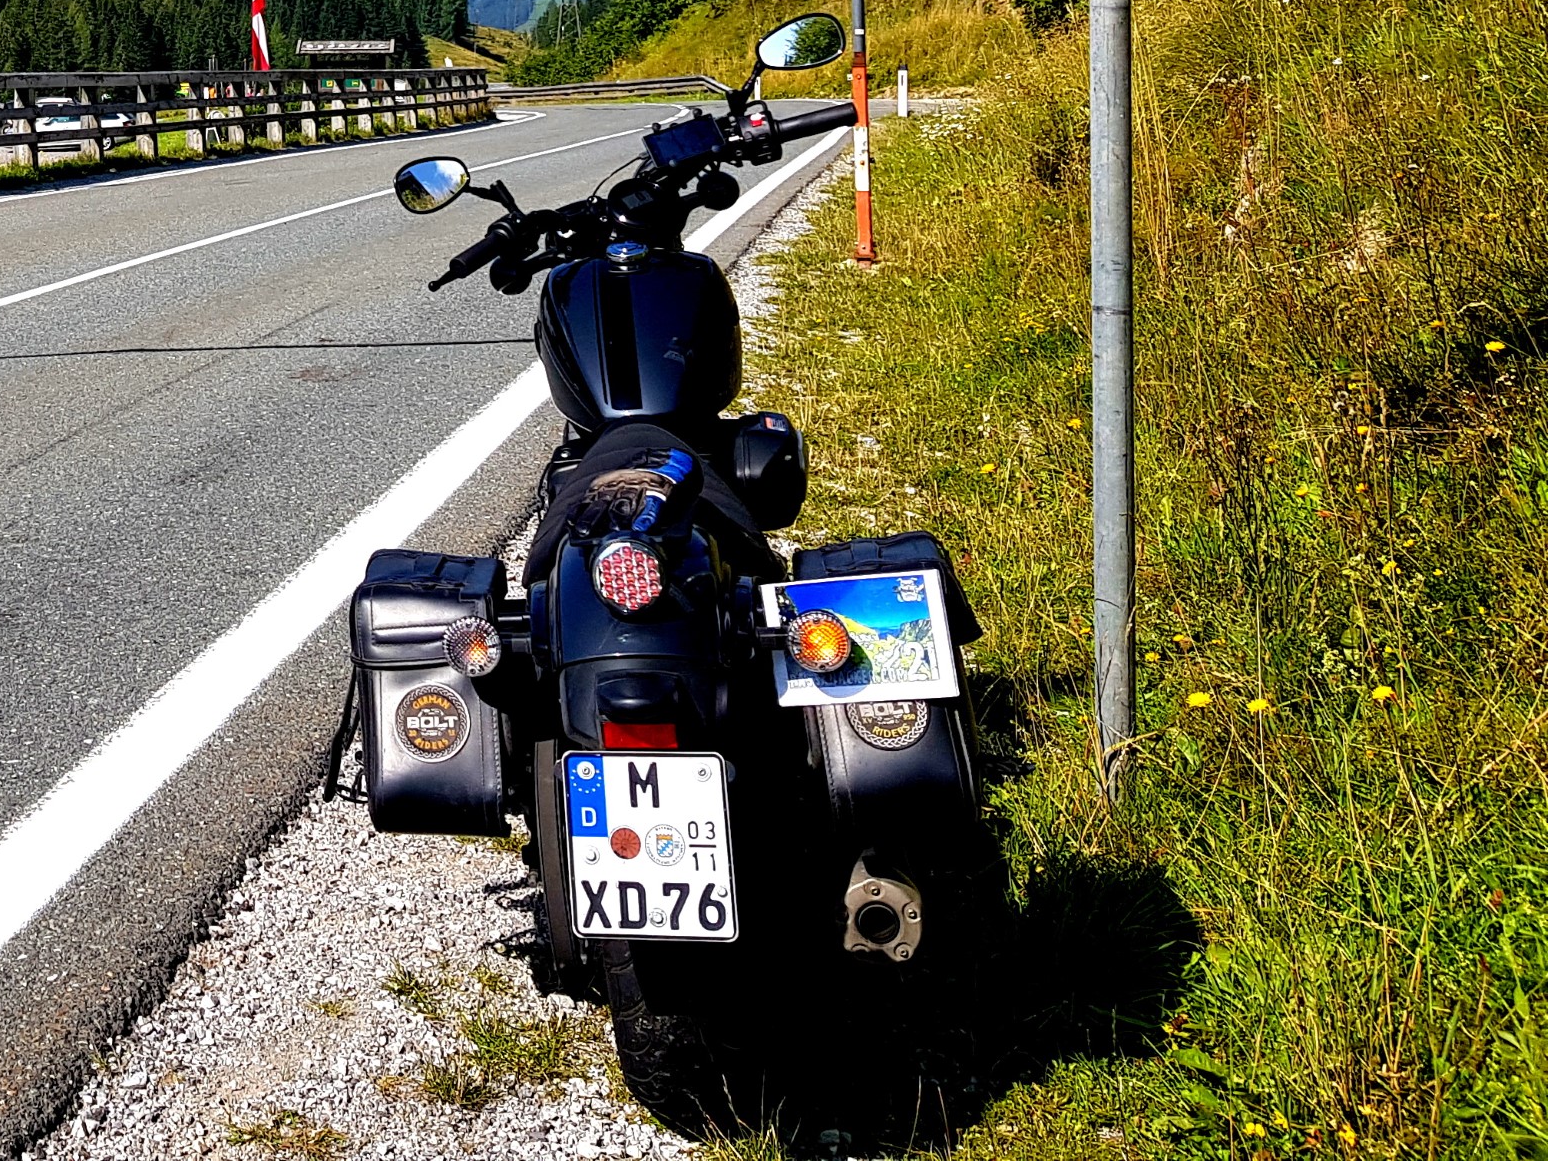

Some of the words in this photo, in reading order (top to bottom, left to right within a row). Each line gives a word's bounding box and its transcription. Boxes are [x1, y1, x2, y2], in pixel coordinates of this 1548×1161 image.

[412, 694, 451, 709] GERMAN
[858, 701, 913, 718] BOLT
[406, 715, 459, 729] BOLT
[902, 713, 916, 721] 950
[872, 722, 911, 738] RIDERS
[413, 737, 450, 750] RIDERS
[627, 761, 660, 808] M
[581, 806, 597, 827] D
[687, 820, 716, 840] 03
[692, 852, 717, 871] 11
[581, 880, 648, 930] XD
[662, 882, 727, 932] 76
